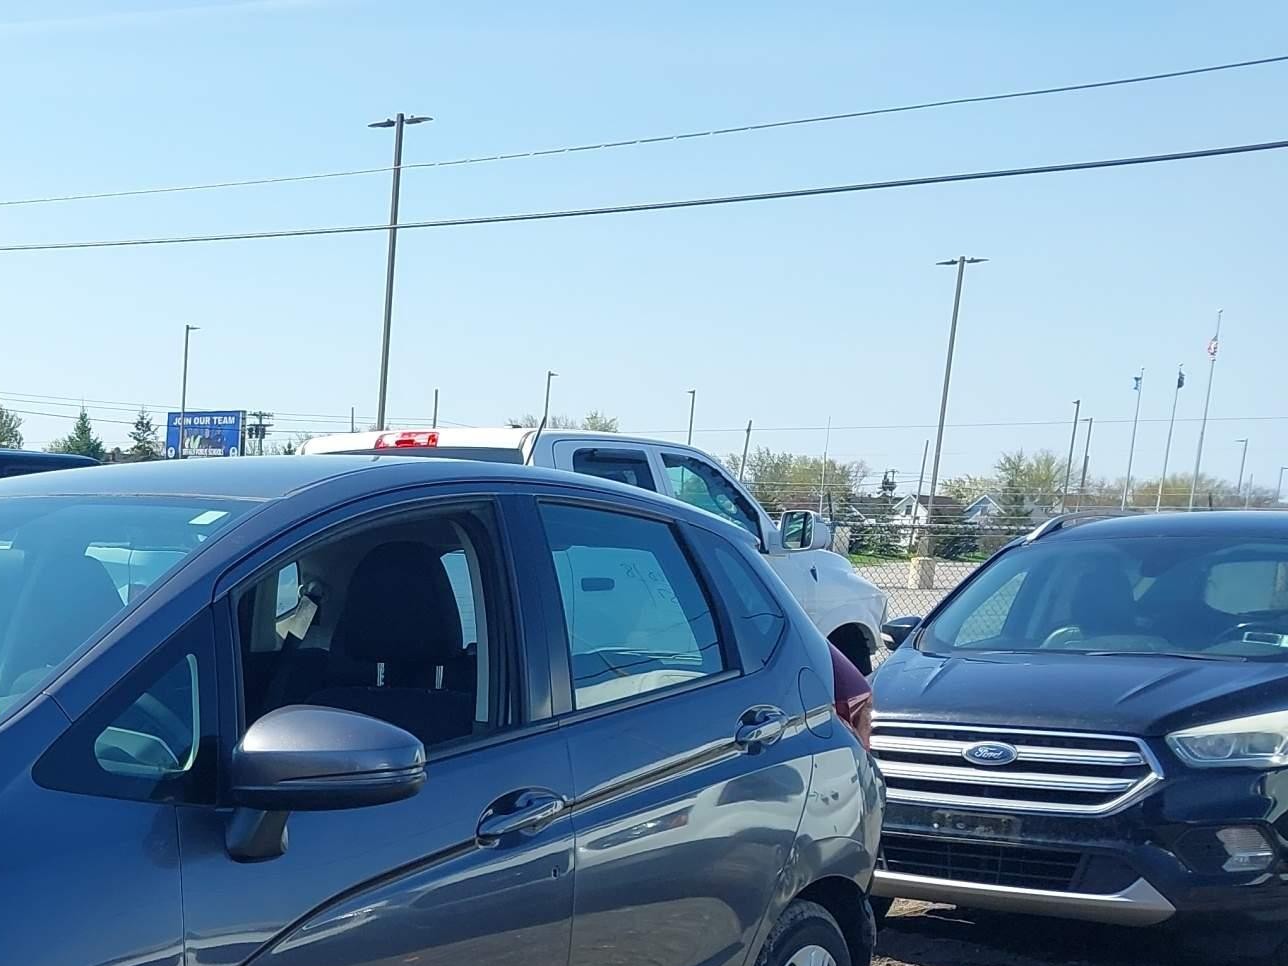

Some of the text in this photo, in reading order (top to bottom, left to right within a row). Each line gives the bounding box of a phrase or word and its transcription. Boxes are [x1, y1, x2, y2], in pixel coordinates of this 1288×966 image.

[173, 416, 235, 425] JOIN OUR TEAM
[974, 746, 1004, 759] Ford
